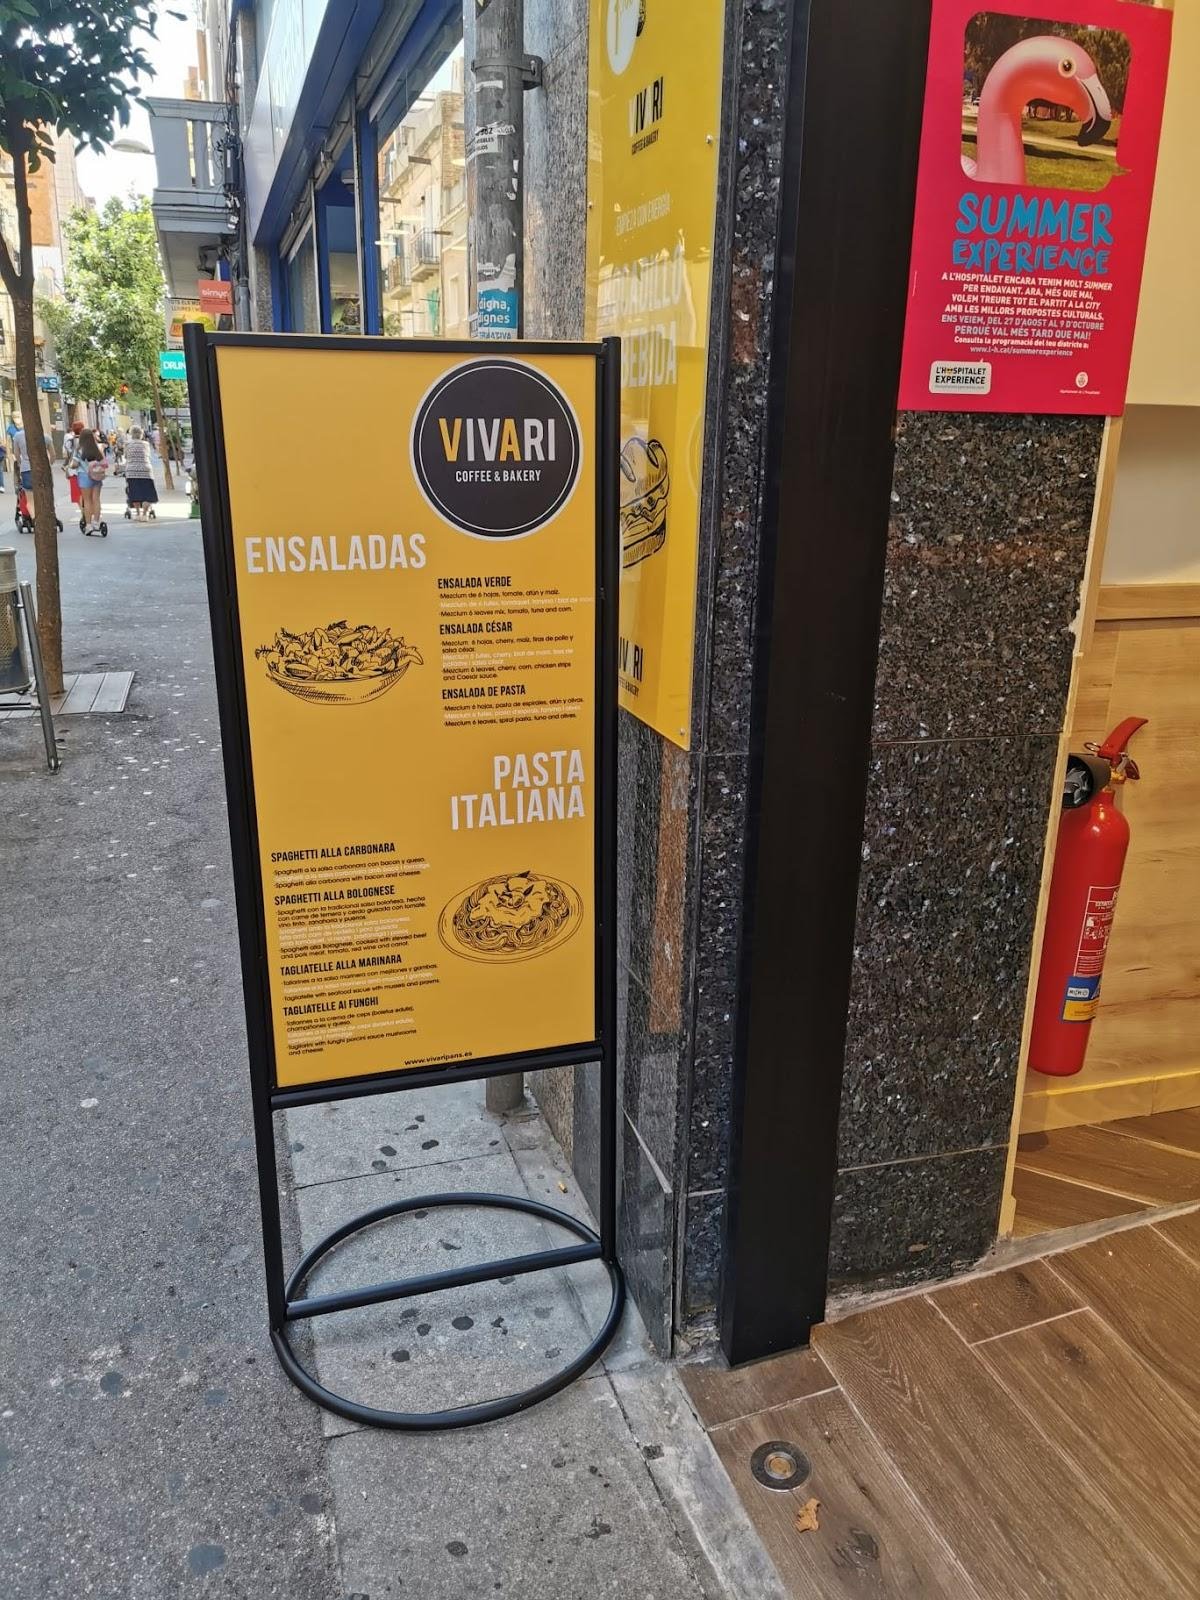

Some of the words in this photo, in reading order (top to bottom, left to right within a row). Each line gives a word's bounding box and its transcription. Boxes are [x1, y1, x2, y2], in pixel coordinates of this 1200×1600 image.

[955, 192, 1114, 246] SUMMER
[952, 239, 1110, 277] EXPERIENCE
[942, 272, 948, 280] A
[949, 272, 1003, 283] L'HOSPITALET
[1004, 276, 1036, 285] ENCARA
[1038, 278, 1062, 286] TENIM
[1064, 280, 1083, 288] MOLT
[1084, 281, 1113, 291] SUMMER
[963, 284, 979, 292] PER
[980, 285, 1024, 295] ENDAVANT.
[1025, 288, 1043, 297] ARA,
[1045, 287, 1061, 297] MÉS
[1062, 290, 1078, 298] QUE
[1078, 291, 1094, 300] MAI,
[952, 294, 978, 303] VOLEM
[980, 295, 1011, 304] TREURE
[1013, 297, 1028, 306] TOT
[1028, 298, 1039, 306] EL
[1040, 299, 1067, 308] PARTIT
[1085, 301, 1101, 310] CITY
[945, 304, 963, 313] AMB
[965, 305, 979, 313] LES
[981, 306, 1015, 315] MILLORS
[1016, 308, 1061, 318] PROPOSTES
[1062, 310, 1104, 320] CULTURALS.
[941, 314, 957, 322] ENS
[960, 316, 985, 324] VEIEM,
[987, 317, 1002, 325] DEL
[1015, 318, 1047, 327] D'AGOST
[1066, 321, 1104, 330] D'OCTUBRE
[992, 327, 1009, 336] VAL
[1010, 327, 1029, 337] MÉS
[1031, 329, 1053, 337] TARD
[1055, 330, 1072, 339] QUE
[954, 336, 983, 344] Consulta
[992, 338, 1033, 346] programació
[1057, 340, 1082, 348] districte
[935, 375, 986, 384] EXPERIENCE
[439, 418, 556, 462] VIVARI
[456, 470, 492, 482] COFFEE
[494, 471, 501, 482] &
[503, 470, 542, 482] BAKERY
[245, 533, 427, 574] ENSALADAS
[438, 577, 482, 589] ENSALADA
[484, 576, 512, 587] VERDE
[440, 623, 483, 635] ENSALADA
[486, 620, 512, 633] CÉSAR
[442, 687, 485, 700] ENSALADA
[488, 686, 498, 696] DE
[501, 684, 526, 695] PASTA
[494, 749, 585, 790] PASTA
[451, 785, 585, 830] ITALIANA
[271, 849, 318, 862] SPAGHETTI
[321, 847, 342, 858] ALLA
[344, 843, 396, 856] CARBONARA
[274, 892, 321, 905] SPAGHETTI
[324, 890, 344, 901] ALLA
[347, 885, 395, 899] BOLOGNESE
[281, 962, 333, 976] TAGLIATELLE
[336, 960, 356, 970] ALLA
[359, 954, 402, 967] MARINARA
[283, 1001, 336, 1016] TAGLIATELLE
[338, 1000, 346, 1010] AI
[349, 996, 378, 1008] FUNGHI
[404, 1051, 472, 1065] www.vivaripans.es
